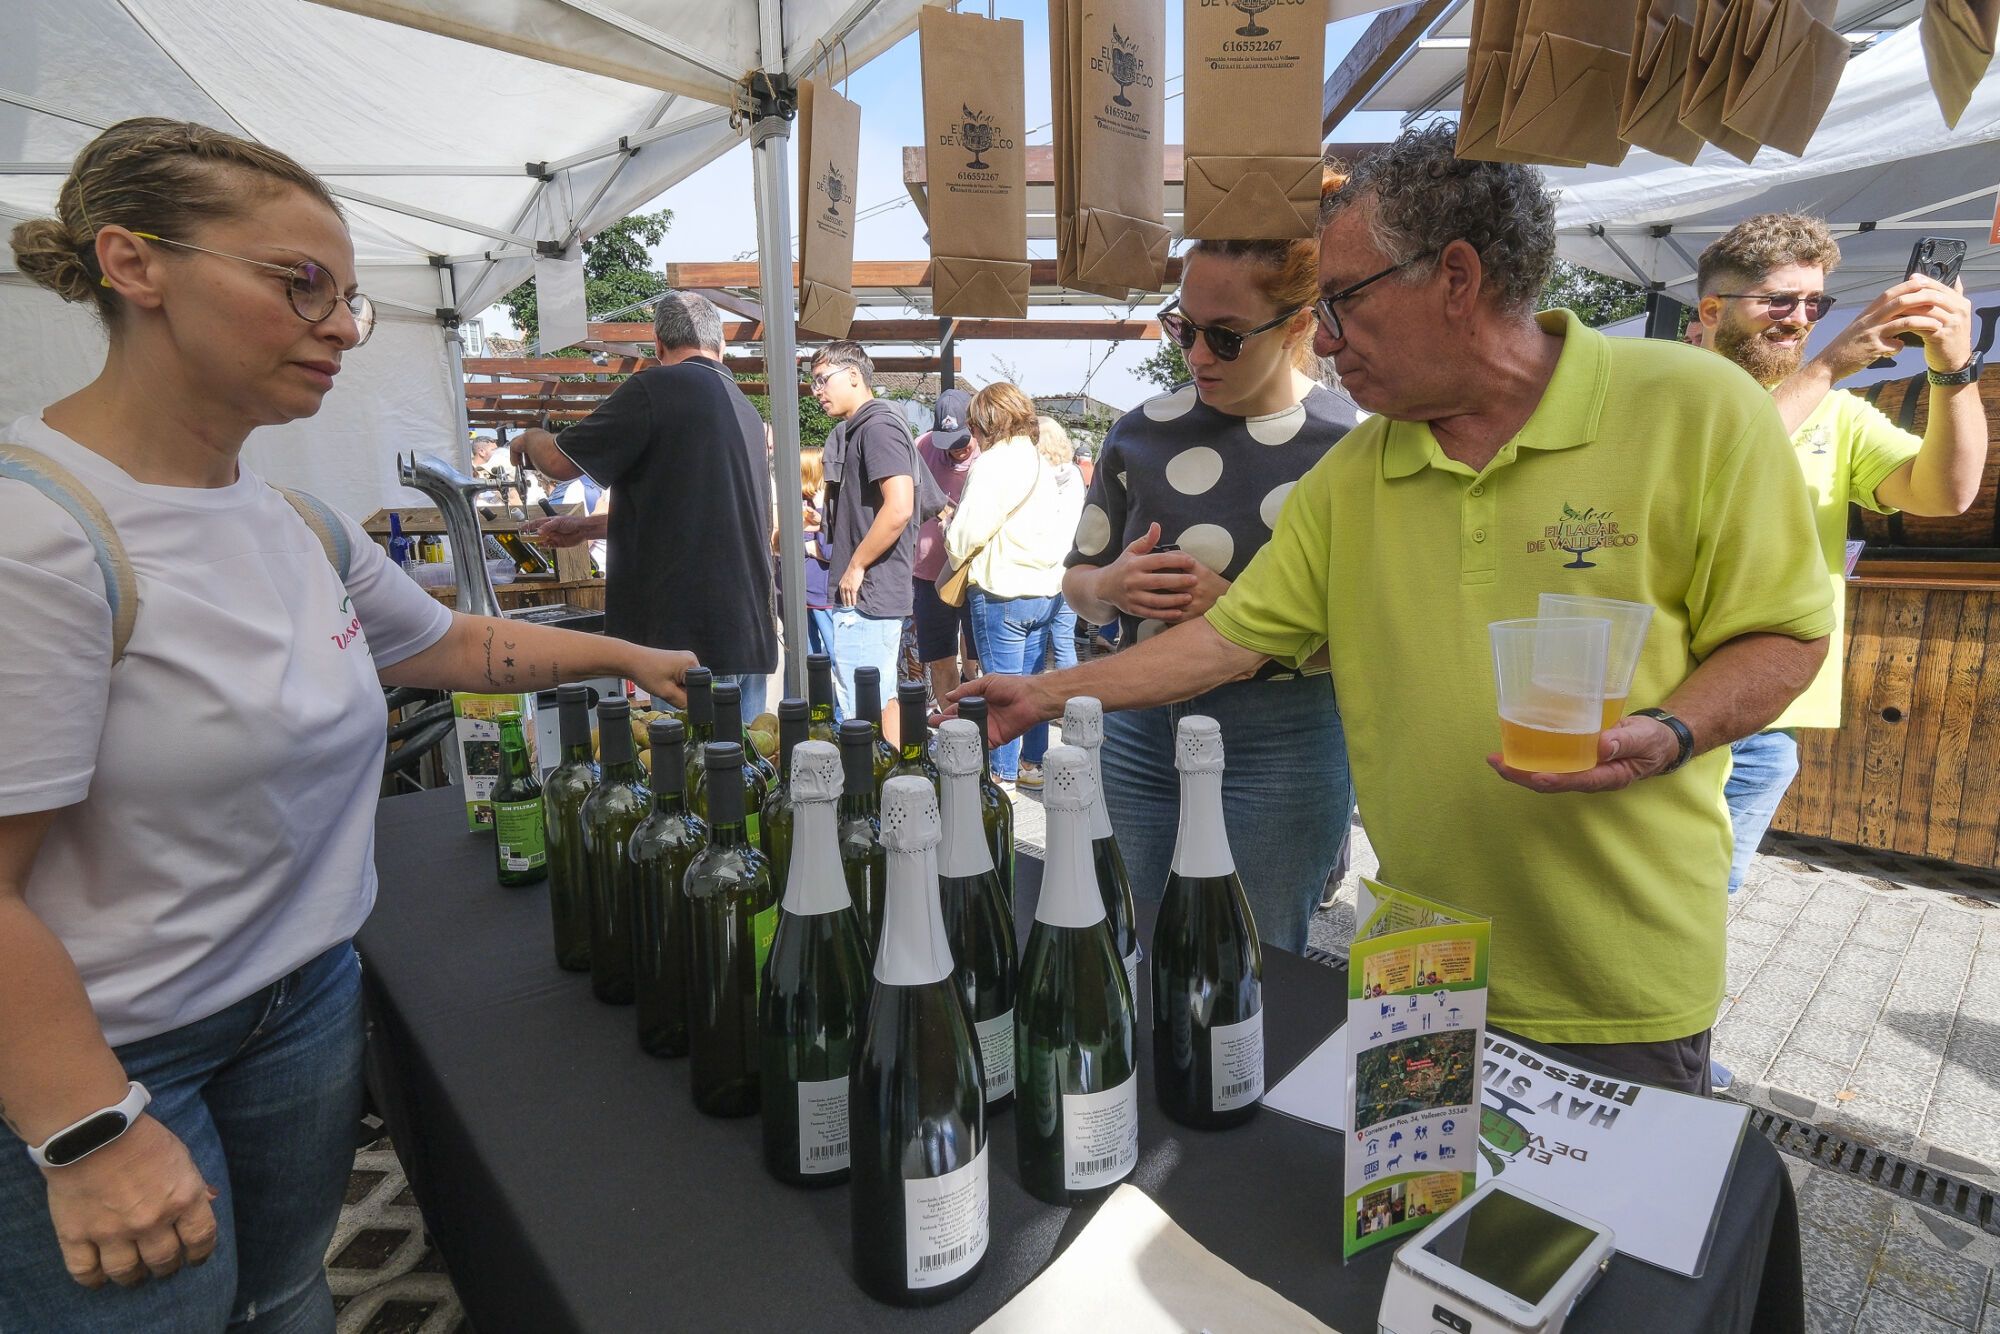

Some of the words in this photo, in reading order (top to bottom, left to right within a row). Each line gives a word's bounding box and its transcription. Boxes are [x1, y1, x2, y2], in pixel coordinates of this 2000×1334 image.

[1223, 40, 1283, 52] 616552267
[1090, 57, 1104, 72] DE
[1104, 104, 1140, 124] 616552267
[940, 135, 954, 146] DE
[957, 171, 999, 182] 616552267
[1544, 526, 1562, 539] EL
[1565, 521, 1620, 538] LAGAR
[1526, 540, 1546, 553] DE
[1548, 532, 1639, 551] VALLESECO
[1421, 1111, 1447, 1120] Valleseco
[1537, 1091, 1621, 1130] HAY
[1552, 1141, 1588, 1162] DE
[1364, 1161, 1379, 1174] BUS
